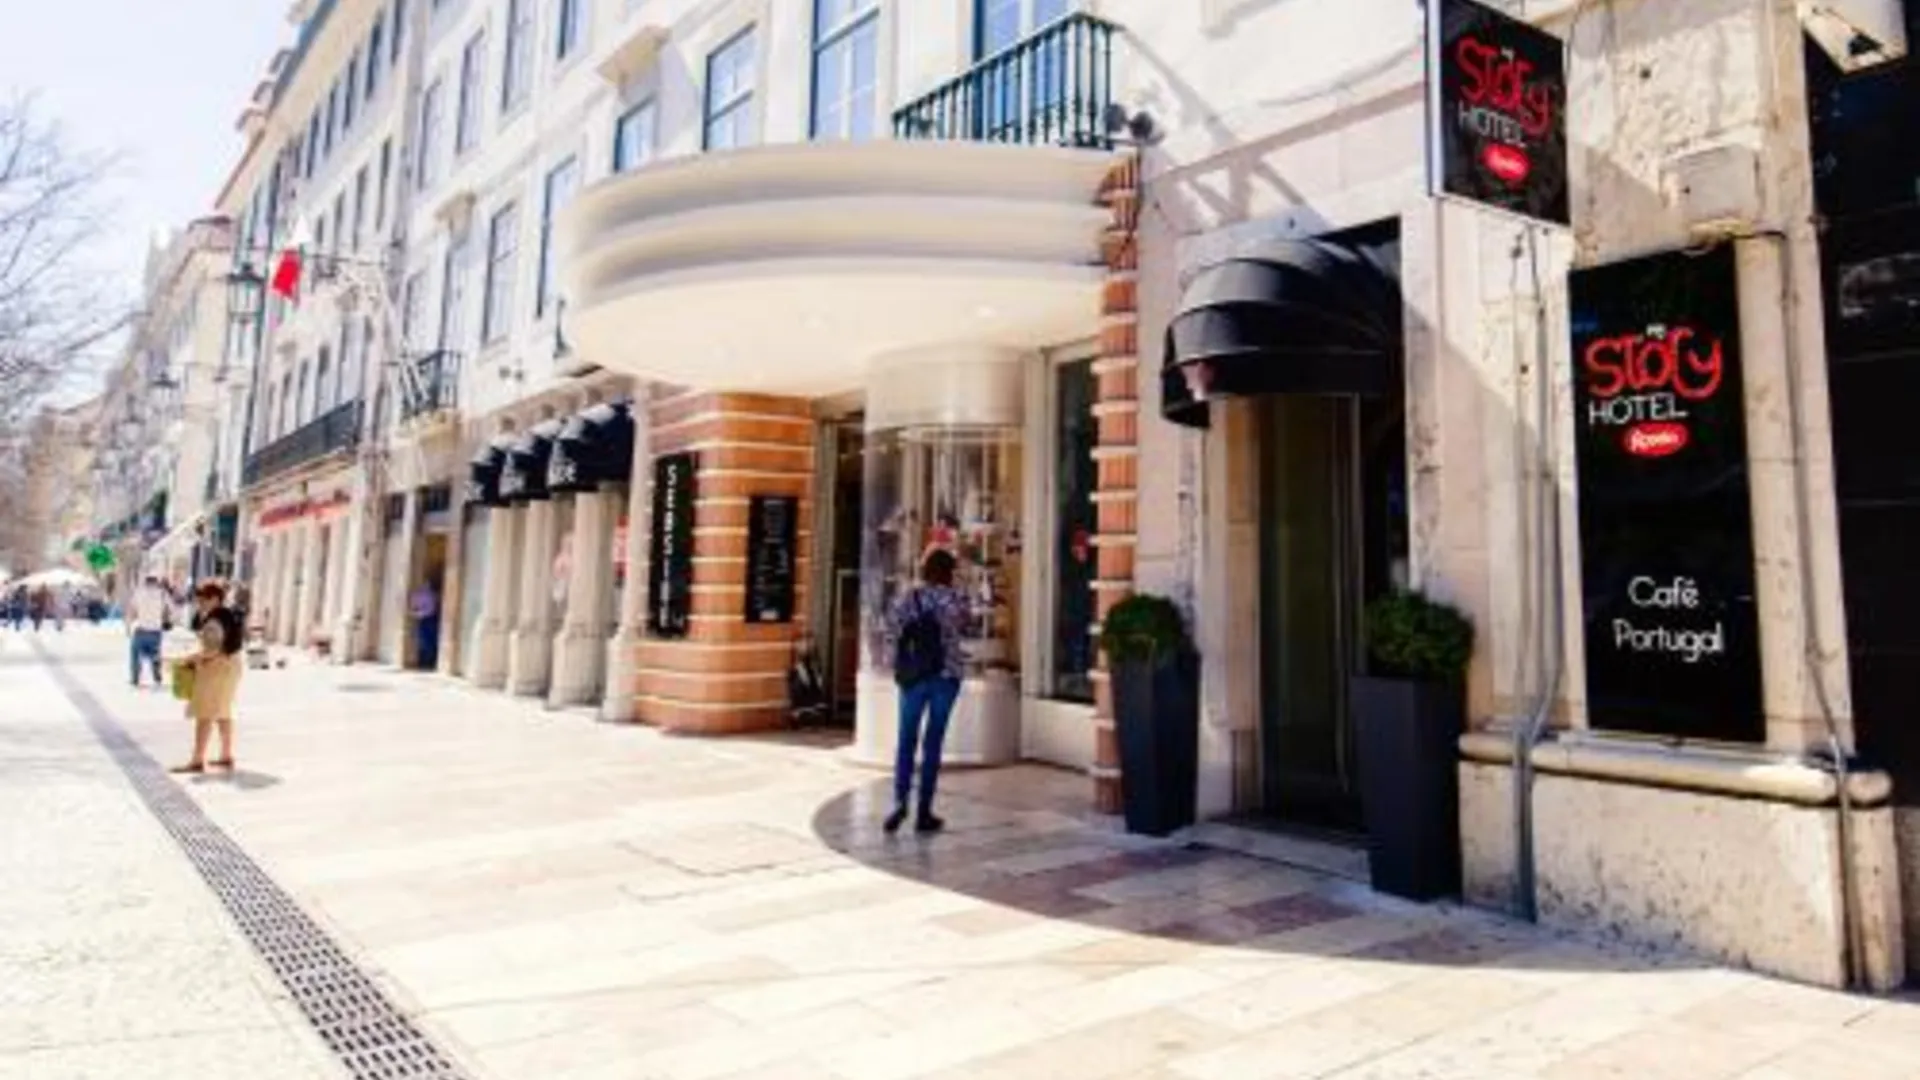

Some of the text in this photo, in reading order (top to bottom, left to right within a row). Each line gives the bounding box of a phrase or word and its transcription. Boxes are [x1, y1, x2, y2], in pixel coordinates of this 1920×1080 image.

[1458, 100, 1527, 148] HOTEL
[1588, 393, 1688, 424] HOTEL
[1626, 575, 1699, 608] Café
[1612, 617, 1724, 663] Portugal
